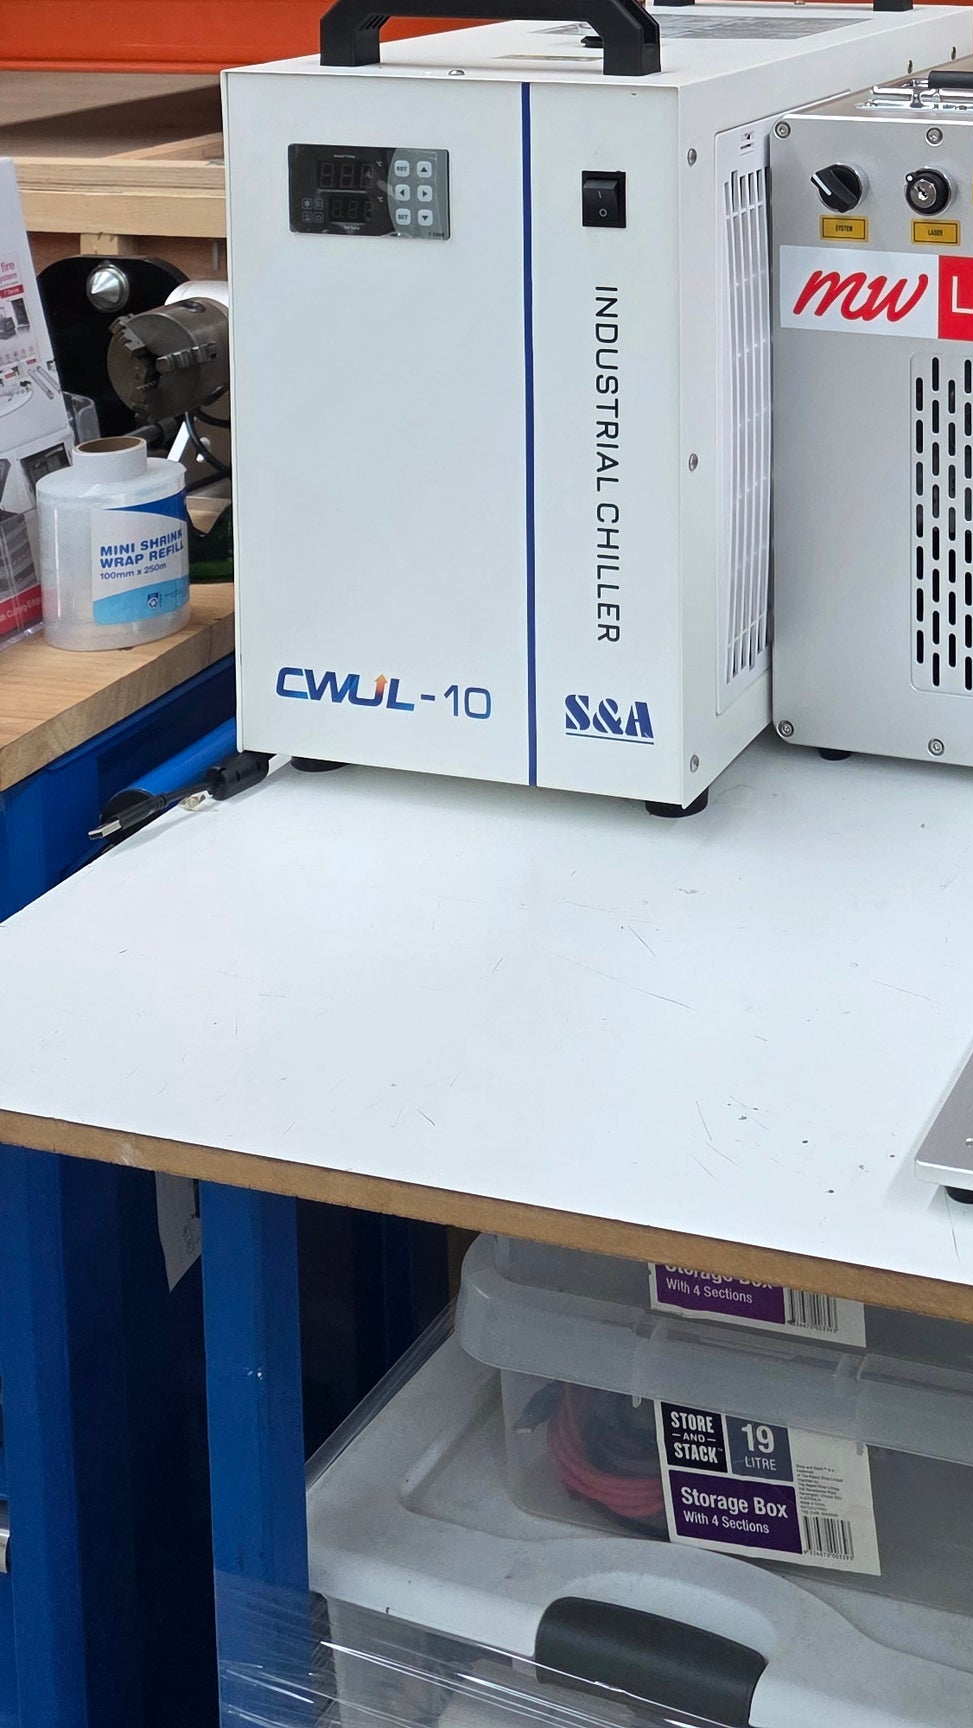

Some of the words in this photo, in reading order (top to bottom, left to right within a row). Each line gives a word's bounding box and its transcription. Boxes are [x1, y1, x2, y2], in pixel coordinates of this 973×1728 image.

[835, 224, 853, 232] SYSTEM
[792, 269, 929, 323] mw
[594, 286, 619, 493] INDUSTRIAL
[100, 543, 135, 557] MINI
[141, 528, 183, 551] SHRINK
[100, 554, 144, 569] WRAP
[149, 542, 184, 561] REFILL
[100, 570, 134, 580] 100mm
[144, 562, 167, 574] 250m
[596, 503, 621, 643] CHILLER
[565, 694, 655, 739] S&A
[666, 1277, 690, 1295] With
[693, 1285, 700, 1295] 4
[704, 1286, 753, 1304] Sections
[670, 1411, 714, 1433] STORE
[683, 1432, 705, 1443] AND
[741, 1423, 775, 1453] 19
[744, 1456, 777, 1471] LITRE
[681, 1486, 748, 1515] Storage
[753, 1497, 788, 1518] Box
[683, 1510, 709, 1525] With
[712, 1515, 719, 1526] 4
[722, 1517, 770, 1534] Sections
